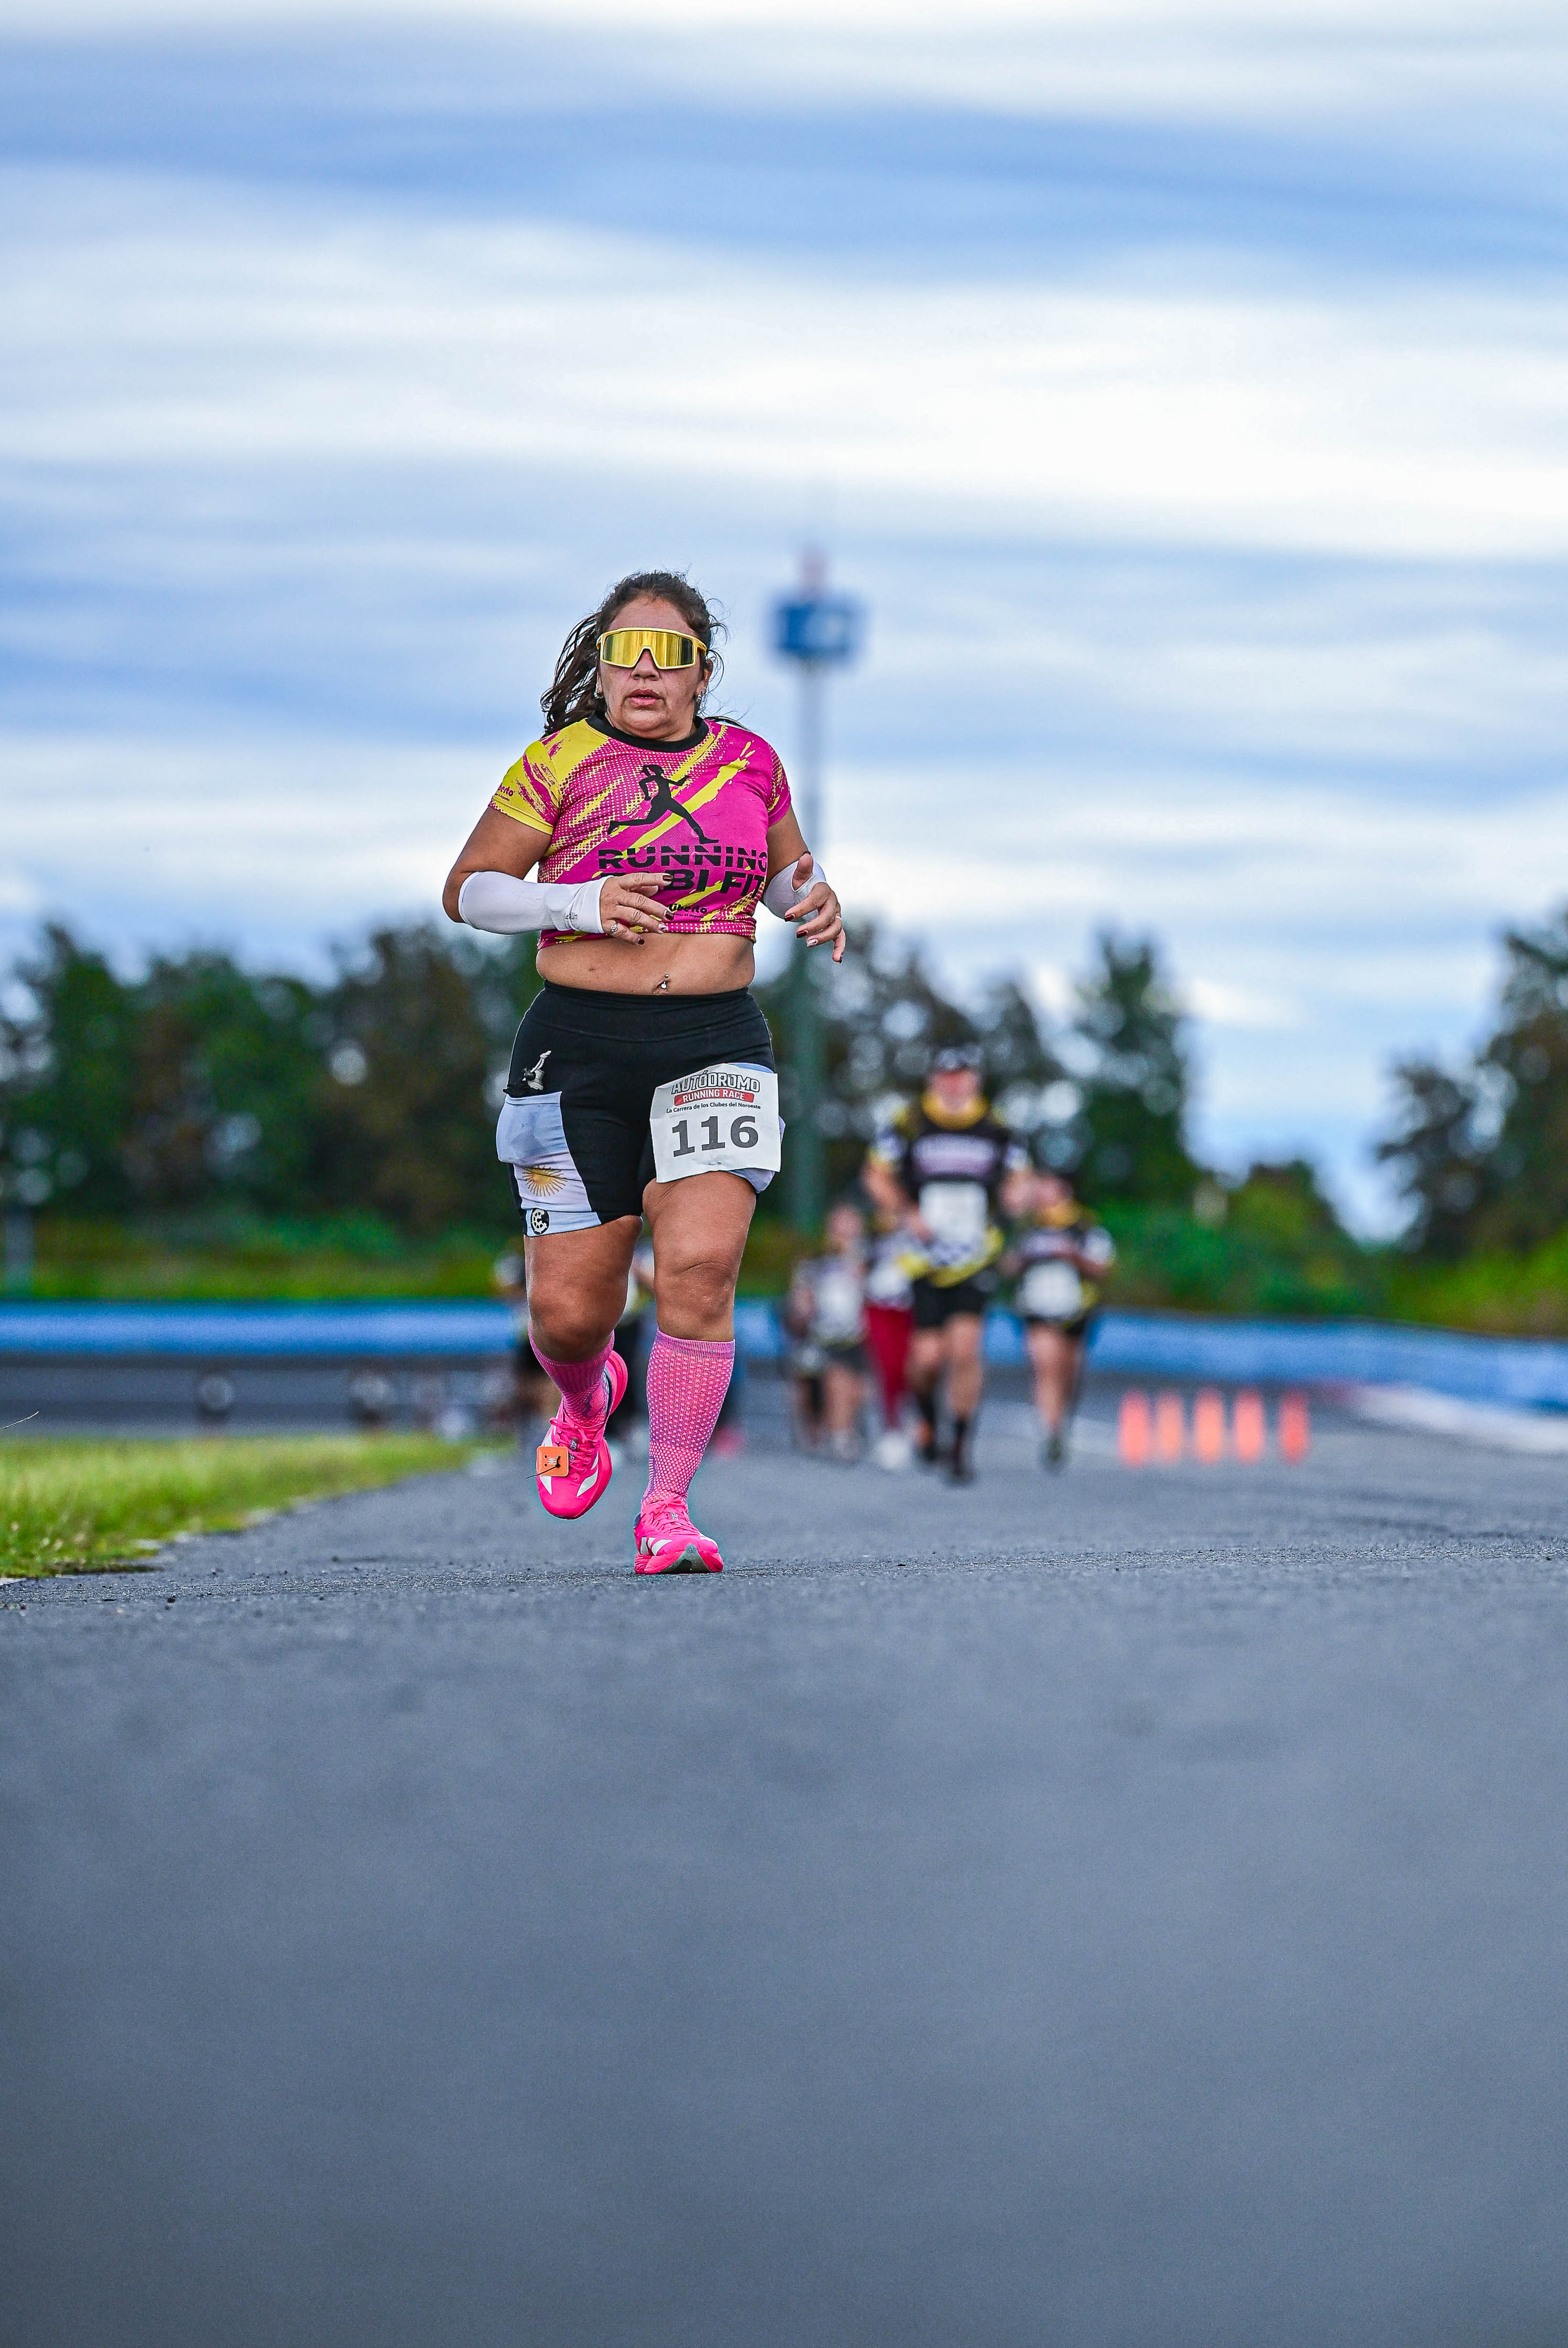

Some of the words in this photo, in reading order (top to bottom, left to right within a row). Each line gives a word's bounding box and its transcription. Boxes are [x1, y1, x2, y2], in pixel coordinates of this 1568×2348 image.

[598, 845, 767, 873] RUNNING
[719, 870, 765, 898] FIT
[671, 1070, 760, 1094] AUTÓDROMO
[683, 1089, 720, 1103] RUNNING
[722, 1089, 745, 1100] RACE
[672, 1116, 759, 1158] 116
